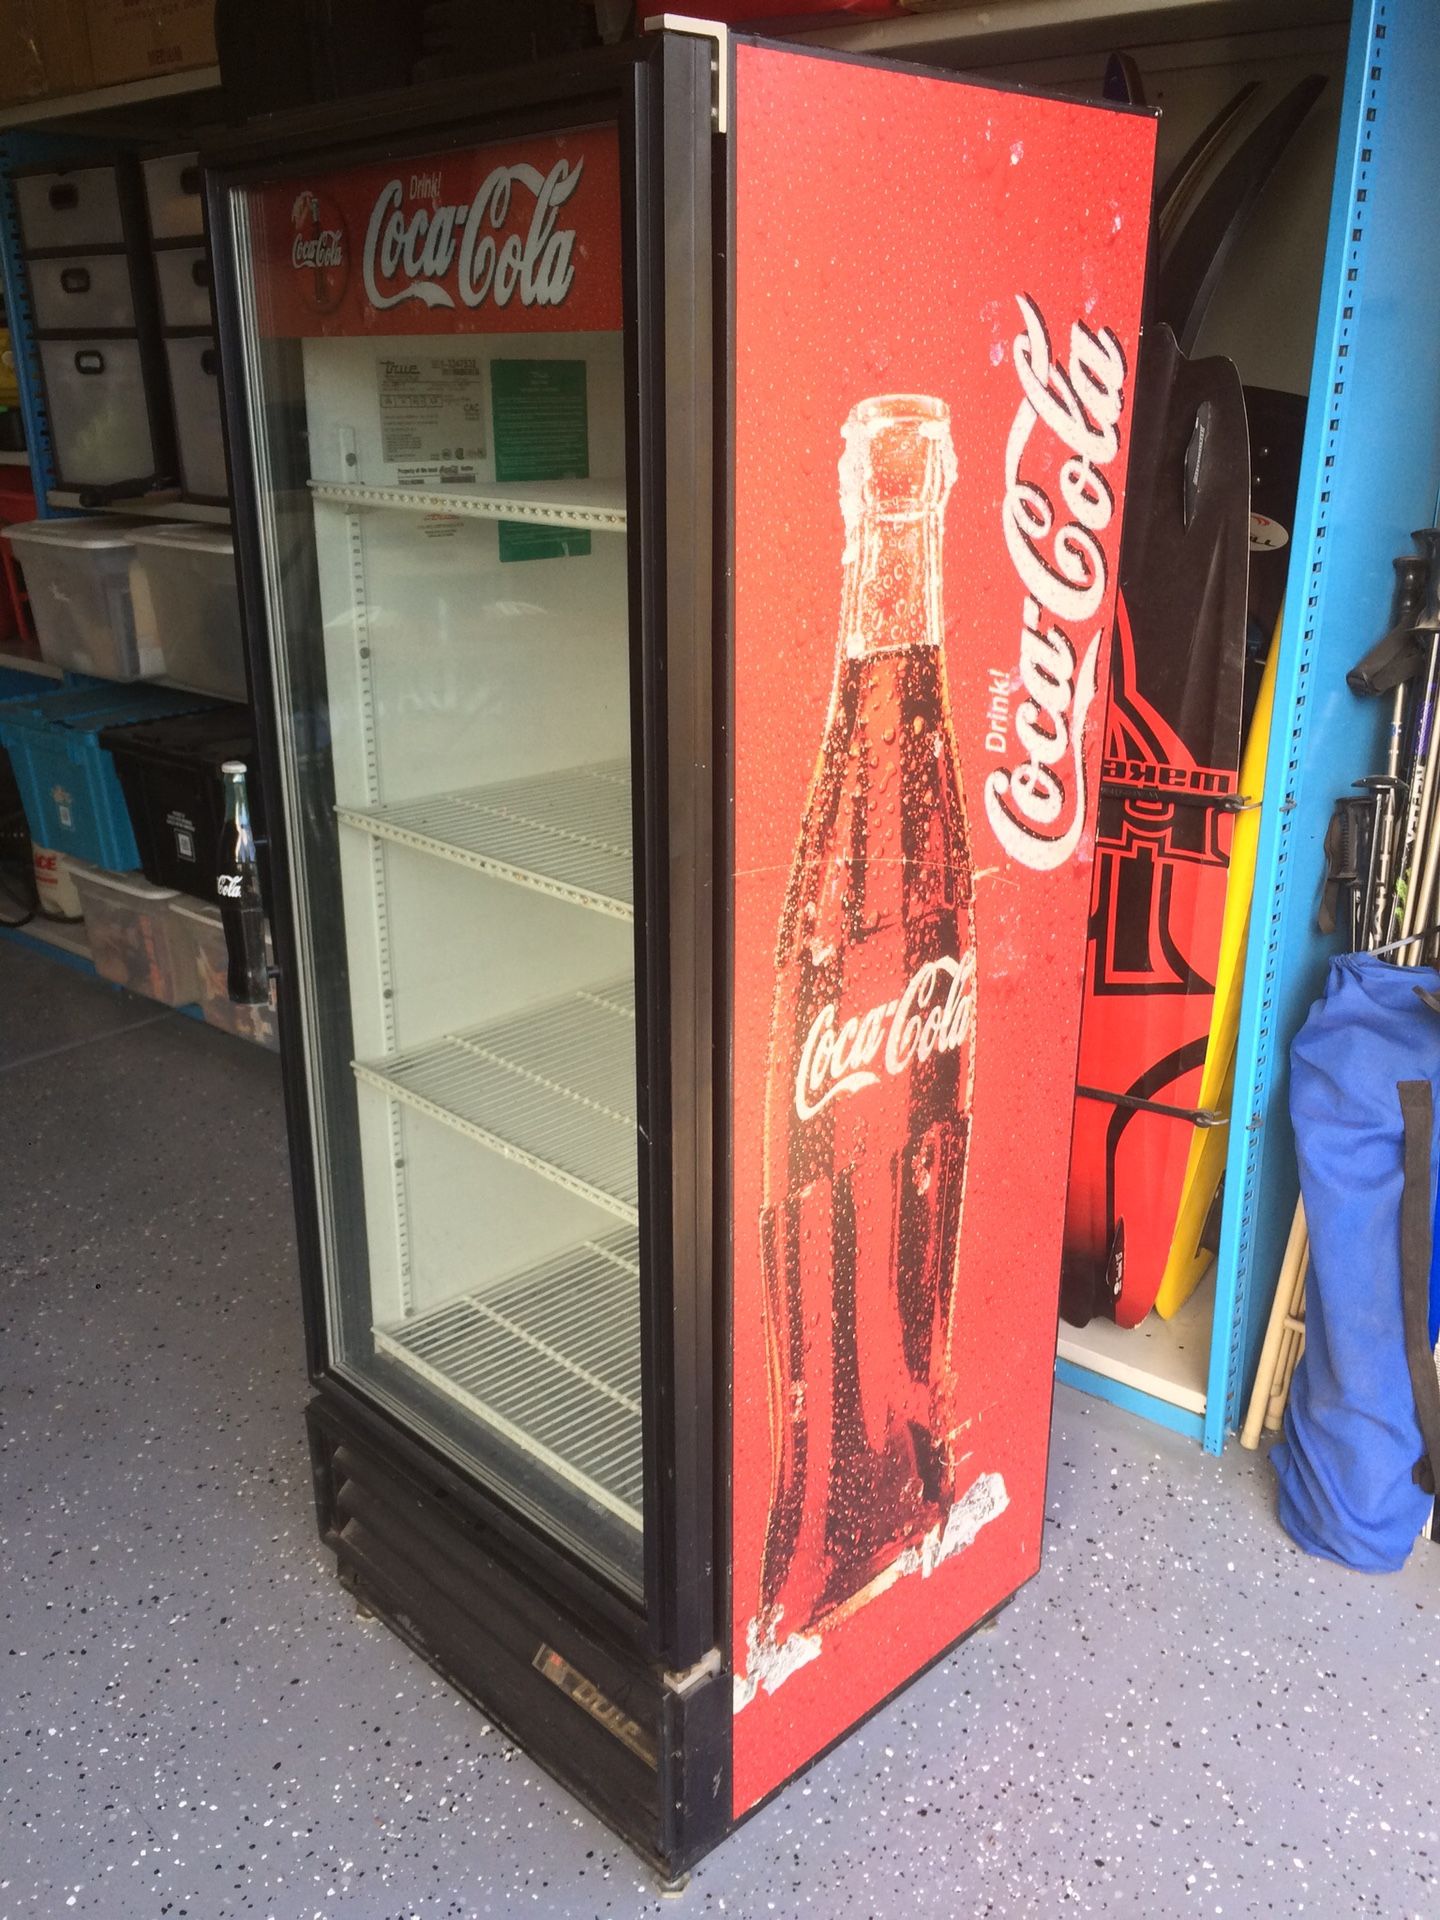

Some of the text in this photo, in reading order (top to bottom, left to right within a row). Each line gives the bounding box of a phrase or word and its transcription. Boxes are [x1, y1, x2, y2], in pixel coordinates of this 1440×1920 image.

[363, 154, 584, 310] Coca-Cola
[410, 172, 442, 200] Drink!
[292, 230, 343, 269] Coca-Cola
[984, 291, 1129, 870] Coca-Cola
[984, 667, 1010, 753] Drink!
[795, 950, 977, 1121] Coca-Cola
